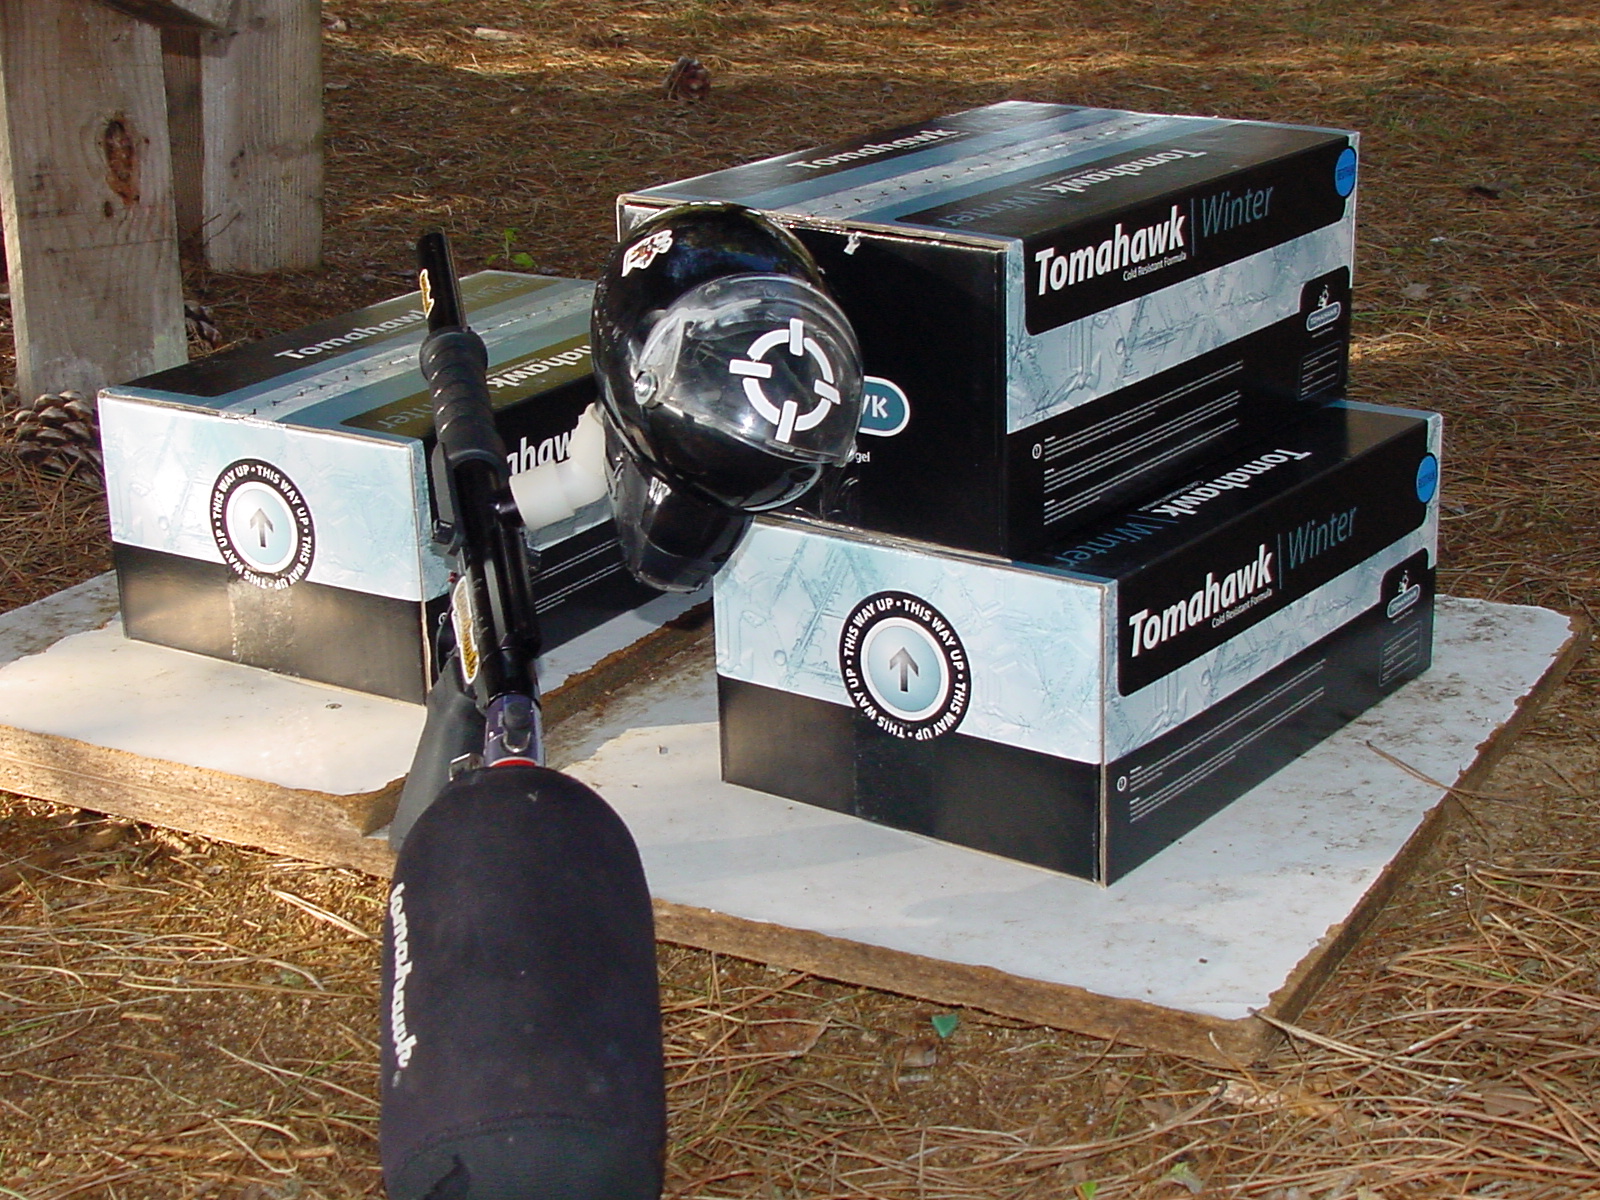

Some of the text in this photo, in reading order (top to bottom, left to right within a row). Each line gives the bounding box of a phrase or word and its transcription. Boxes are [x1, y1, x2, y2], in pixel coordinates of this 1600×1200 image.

[786, 128, 959, 169] Tomahawk
[1041, 149, 1207, 194] Tomahawk
[1035, 186, 1274, 296] Tomahawk Winter
[1123, 267, 1137, 281] Cold
[213, 465, 250, 519] THIS WAY UP
[256, 465, 309, 526] THIS WAY UP
[1151, 449, 1312, 517] Tomahawk
[216, 529, 267, 589] THIS WAY UP
[275, 536, 312, 590] THIS WAY UP
[1055, 521, 1163, 567] Winter
[1128, 506, 1358, 658] Tomahawk Winter
[844, 598, 894, 656] THIS WAY UP
[903, 599, 965, 671] THIS WAY UP
[1212, 612, 1225, 628] Cold
[846, 668, 905, 738] THIS WAY UP
[915, 682, 966, 740] THIS WAY UP
